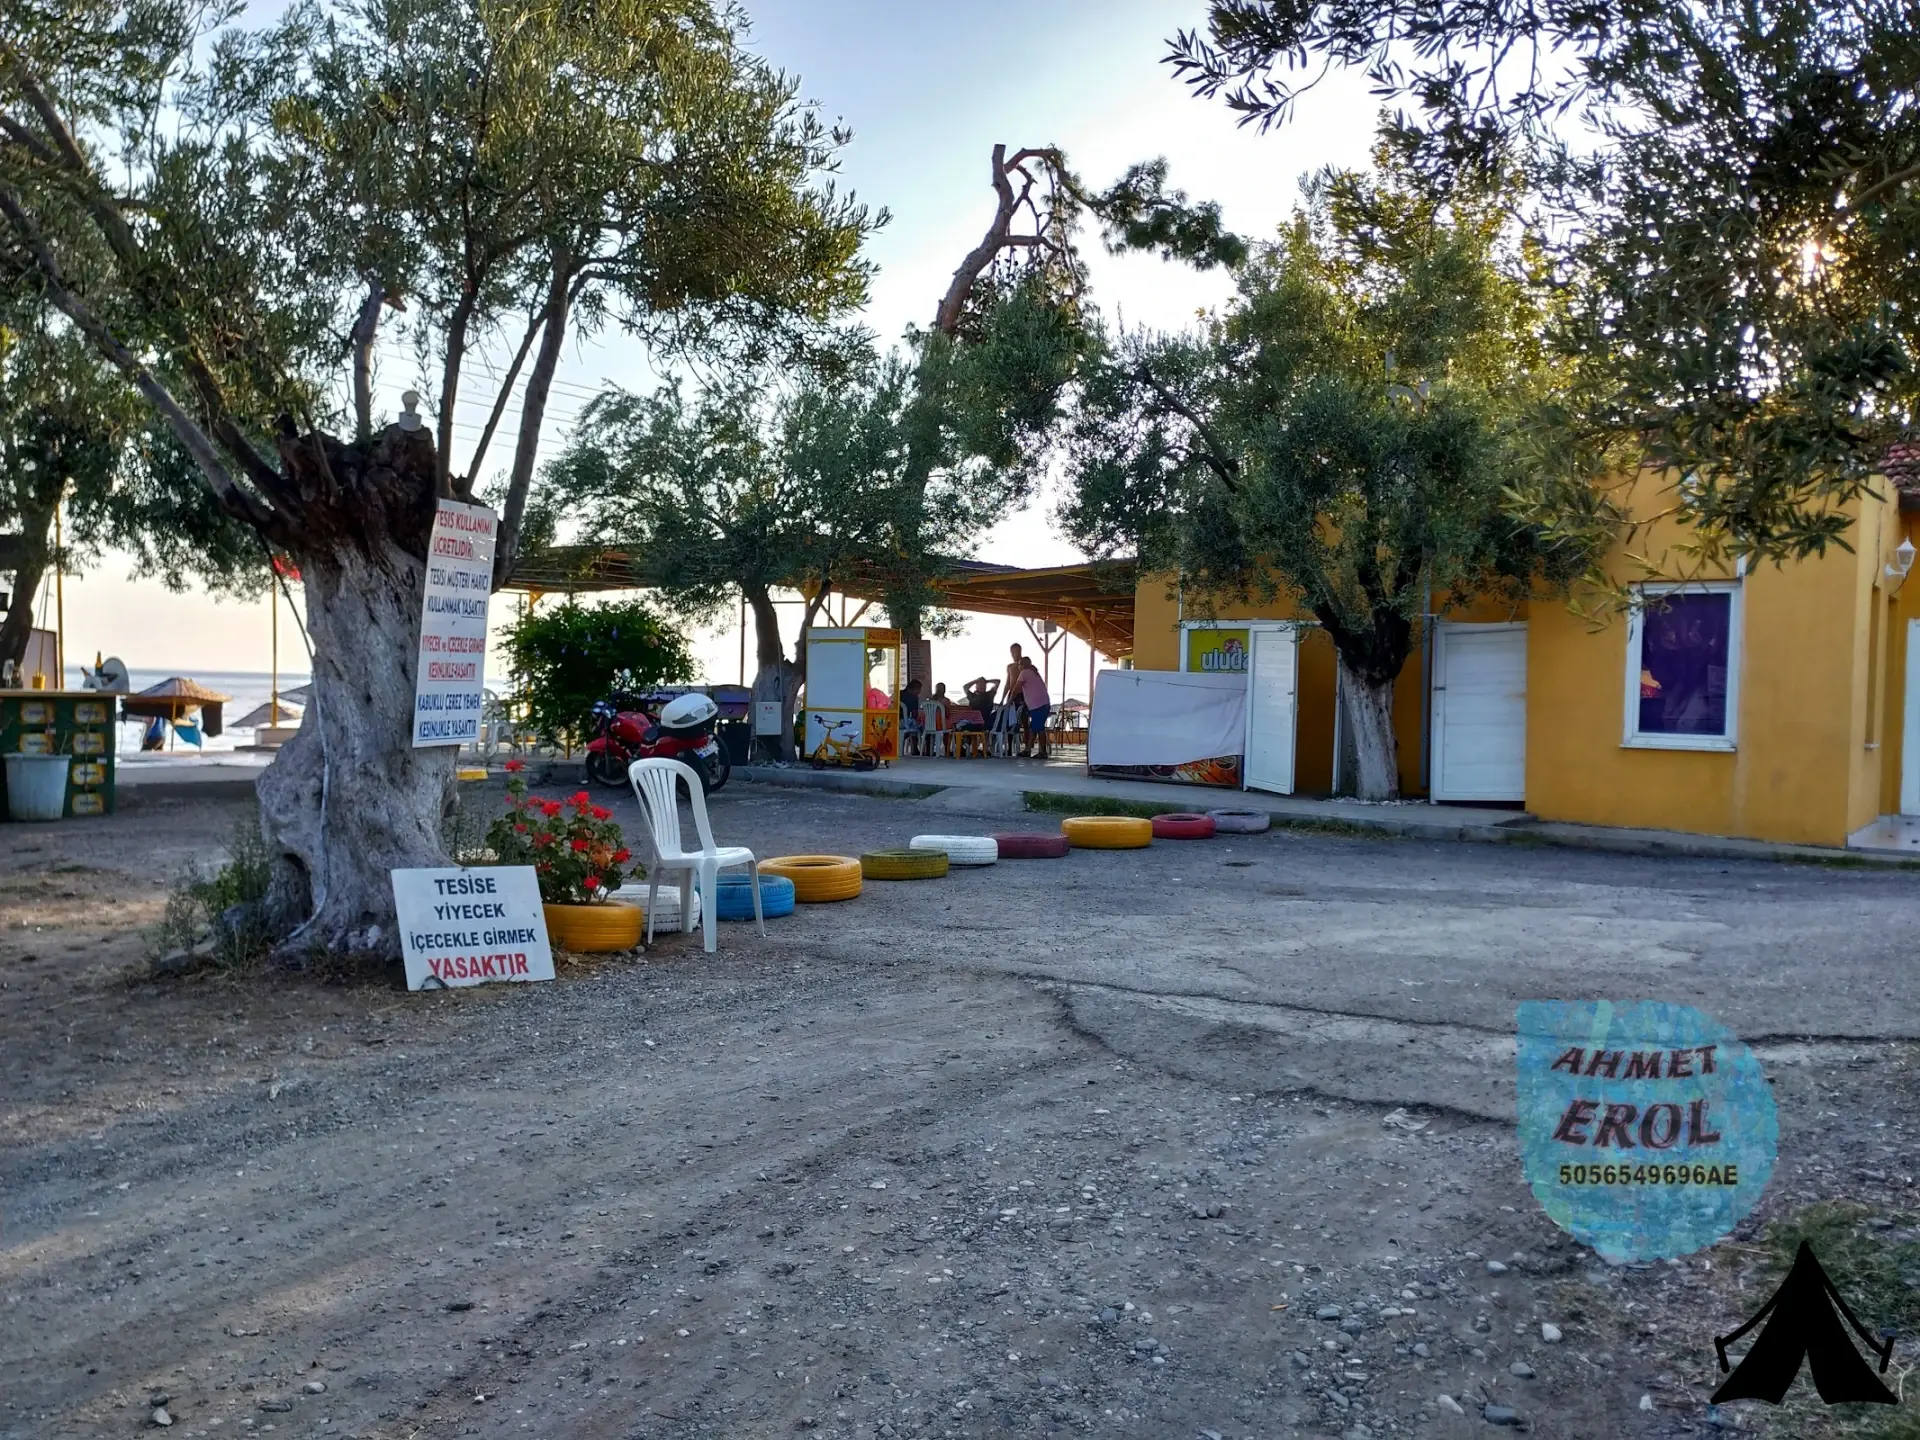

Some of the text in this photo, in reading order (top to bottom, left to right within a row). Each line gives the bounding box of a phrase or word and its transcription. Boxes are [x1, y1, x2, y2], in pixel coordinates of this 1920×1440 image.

[455, 512, 492, 535] KULLANIMI
[427, 595, 486, 617] KULLANMAK YASAKTIR
[417, 693, 444, 711] KABUKLU
[462, 692, 481, 710] YEMEK
[451, 718, 477, 736] YASAKTIR
[434, 875, 497, 896] TESİSE
[433, 902, 506, 921] YİYECEK
[410, 927, 537, 954] İÇECEKLE GİRMEK
[427, 953, 529, 980] YASAKTIR
